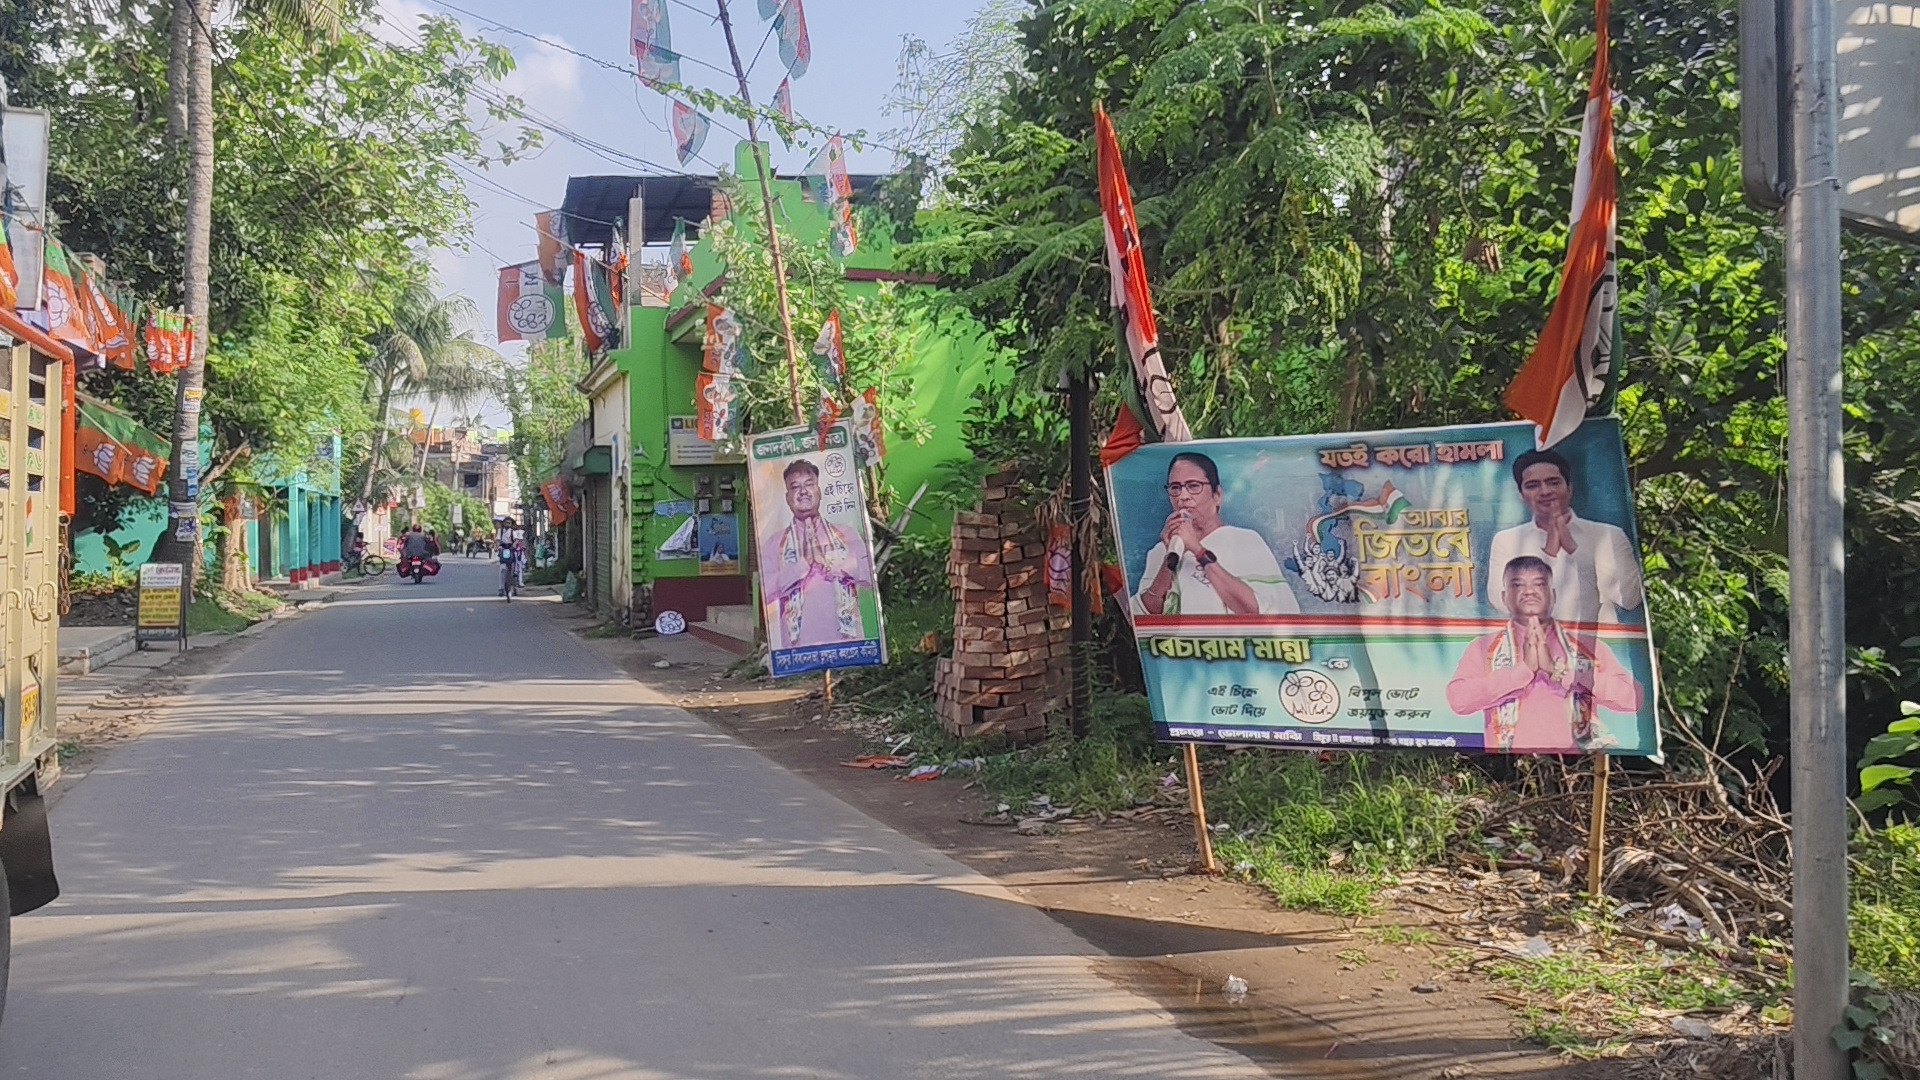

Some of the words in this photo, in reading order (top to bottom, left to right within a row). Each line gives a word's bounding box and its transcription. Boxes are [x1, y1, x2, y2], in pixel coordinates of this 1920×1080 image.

[1318, 443, 1369, 468] যতই
[1373, 444, 1430, 468] করো
[1434, 440, 1504, 464] হামলা
[824, 483, 836, 497] এই
[826, 500, 843, 515] ভোট
[1399, 509, 1470, 528] আবার
[1353, 518, 1471, 563] জিতবে
[1360, 561, 1475, 599] বাংলা
[1149, 636, 1247, 662] বেচারাম
[1251, 637, 1312, 663] মান্না
[1207, 684, 1228, 698] এই
[1229, 684, 1259, 699] চিহ্নে
[1347, 685, 1382, 703] বিপুল
[1386, 686, 1421, 700] ভোটে
[1210, 703, 1239, 717] ভোট
[1240, 703, 1267, 718] দিয়ে
[1393, 707, 1432, 719] করুন
